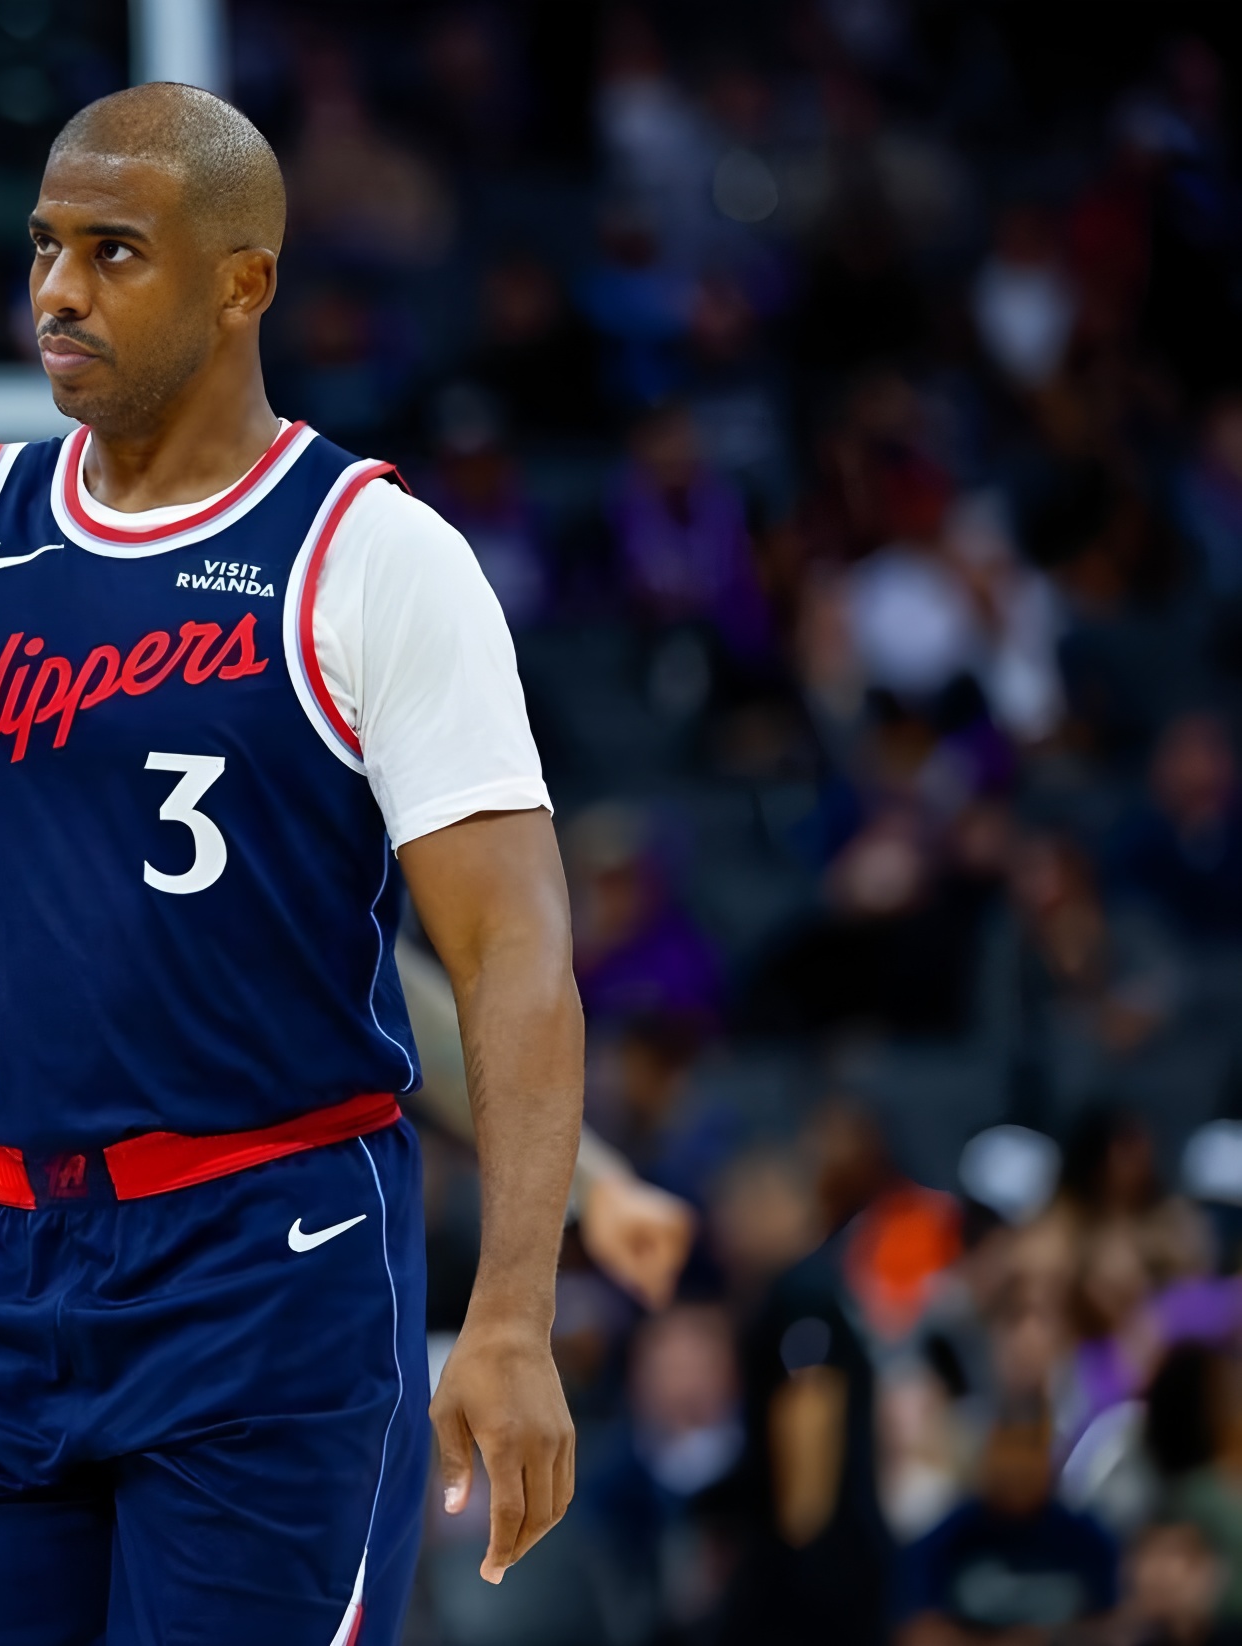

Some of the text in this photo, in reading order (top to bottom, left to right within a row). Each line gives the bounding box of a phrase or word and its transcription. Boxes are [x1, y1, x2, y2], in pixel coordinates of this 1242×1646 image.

[204, 559, 262, 580] VISIT
[175, 572, 275, 597] RWANDA
[143, 751, 228, 895] 3
